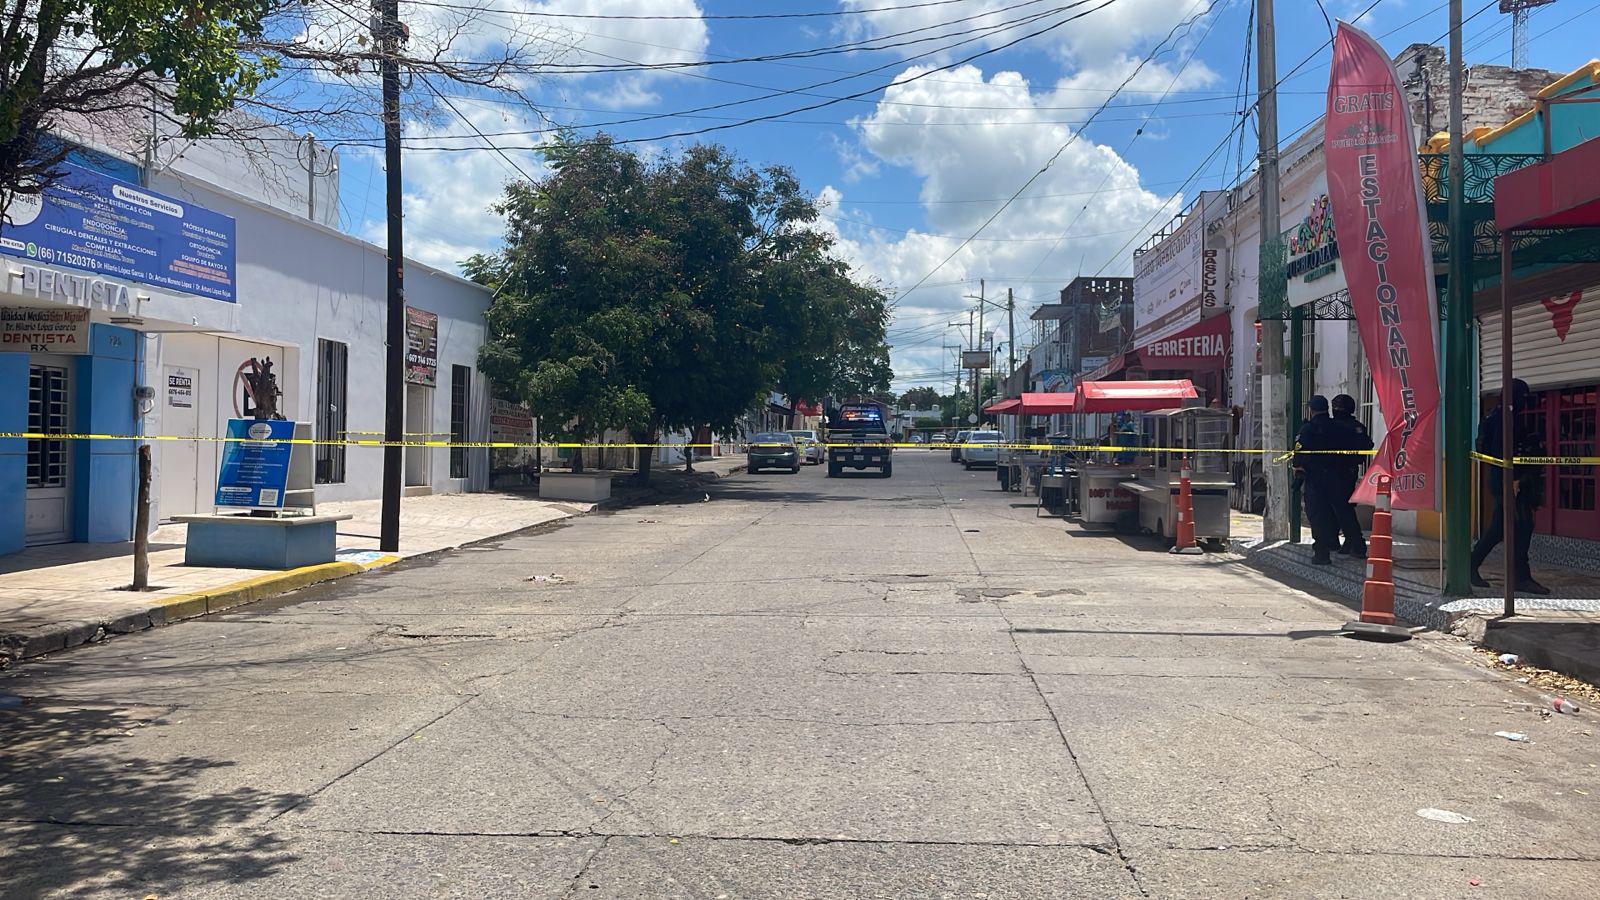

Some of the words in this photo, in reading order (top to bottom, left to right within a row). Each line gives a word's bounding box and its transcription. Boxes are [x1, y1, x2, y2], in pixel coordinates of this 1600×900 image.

[1334, 92, 1395, 114] GRATIS
[118, 189, 149, 205] Nuestros
[149, 199, 179, 214] Servicios
[38, 246, 55, 262] (66)
[56, 250, 97, 271] 71520376
[22, 266, 130, 313] DENTISTA
[1204, 250, 1218, 308] BASCULAS
[1358, 154, 1419, 472] ESTACIONAMIENTO
[3, 333, 77, 344] DENTISTA
[30, 344, 49, 352] RX
[1147, 334, 1225, 357] FERRETERIA
[1519, 456, 1554, 465] PROHIBIDO
[1555, 456, 1563, 464] EL
[1564, 456, 1581, 464] PASO
[1368, 472, 1426, 493] GATIS
